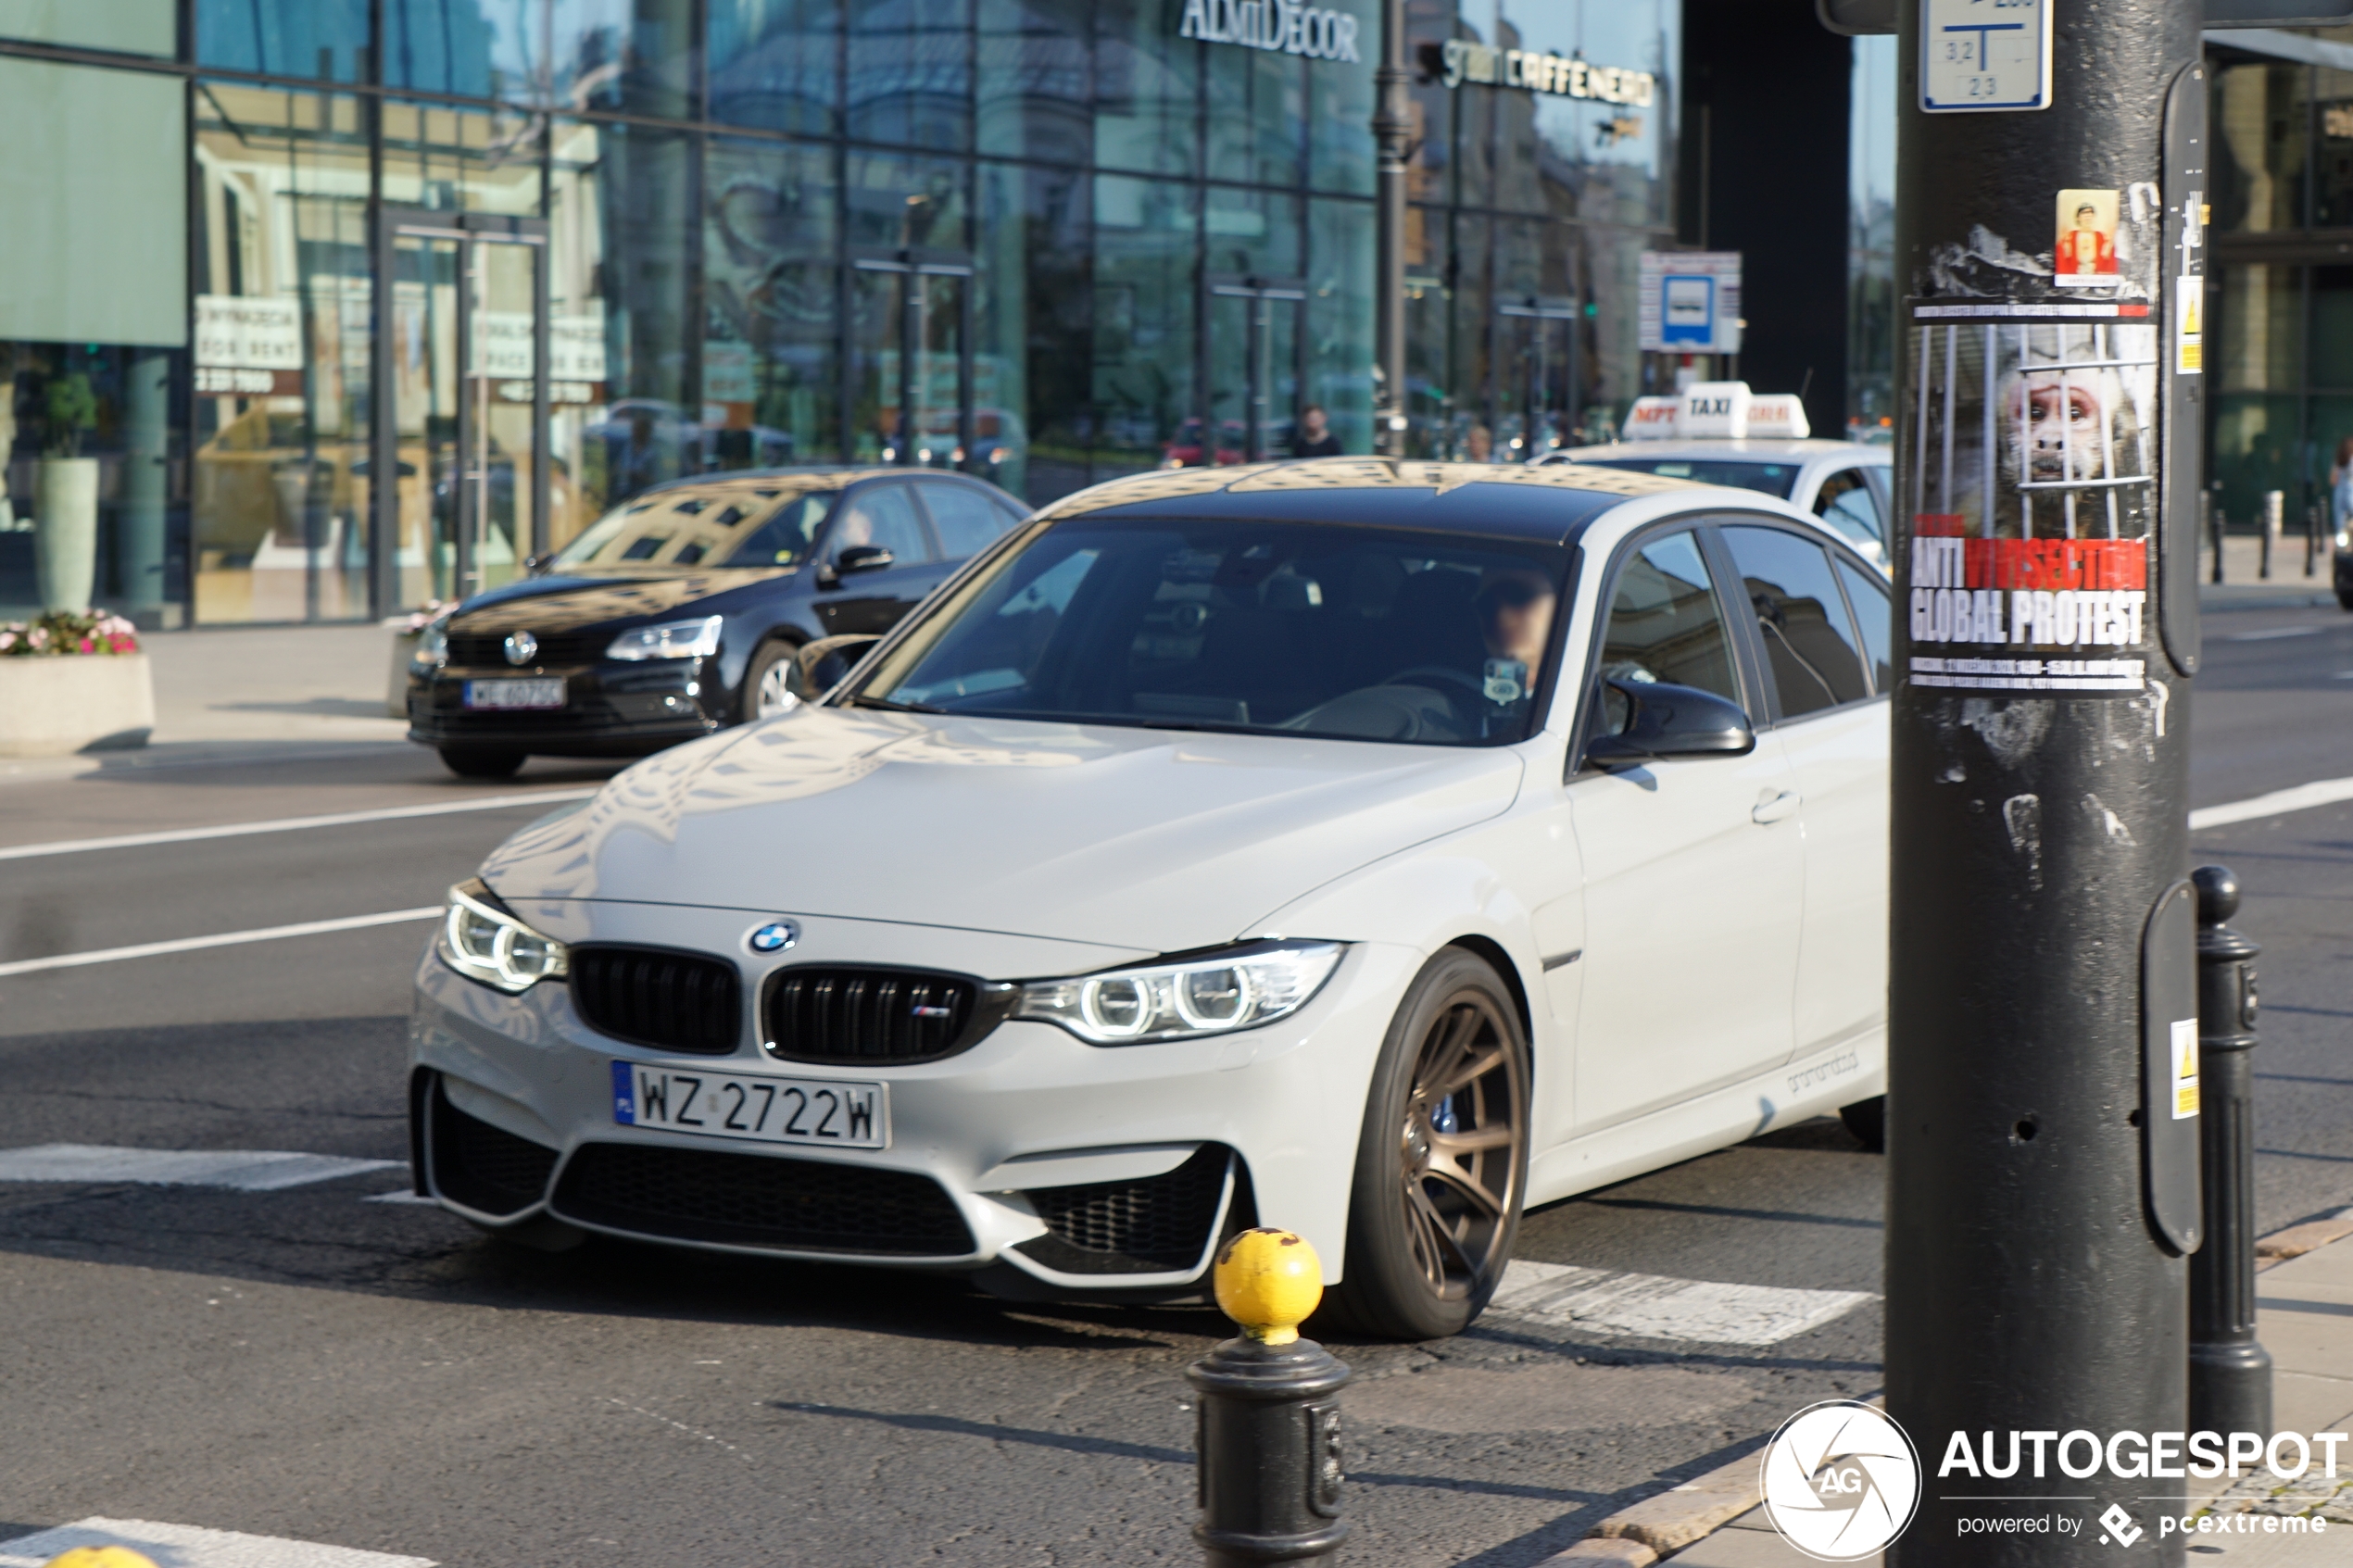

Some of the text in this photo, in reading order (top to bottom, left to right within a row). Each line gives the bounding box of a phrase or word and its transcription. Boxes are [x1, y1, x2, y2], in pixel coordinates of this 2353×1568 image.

[1634, 406, 1679, 424] MPT
[1690, 397, 1730, 417] TAXI
[1910, 587, 2146, 646] GLOBAL PROTEST
[640, 1072, 874, 1140] WZ 2722W
